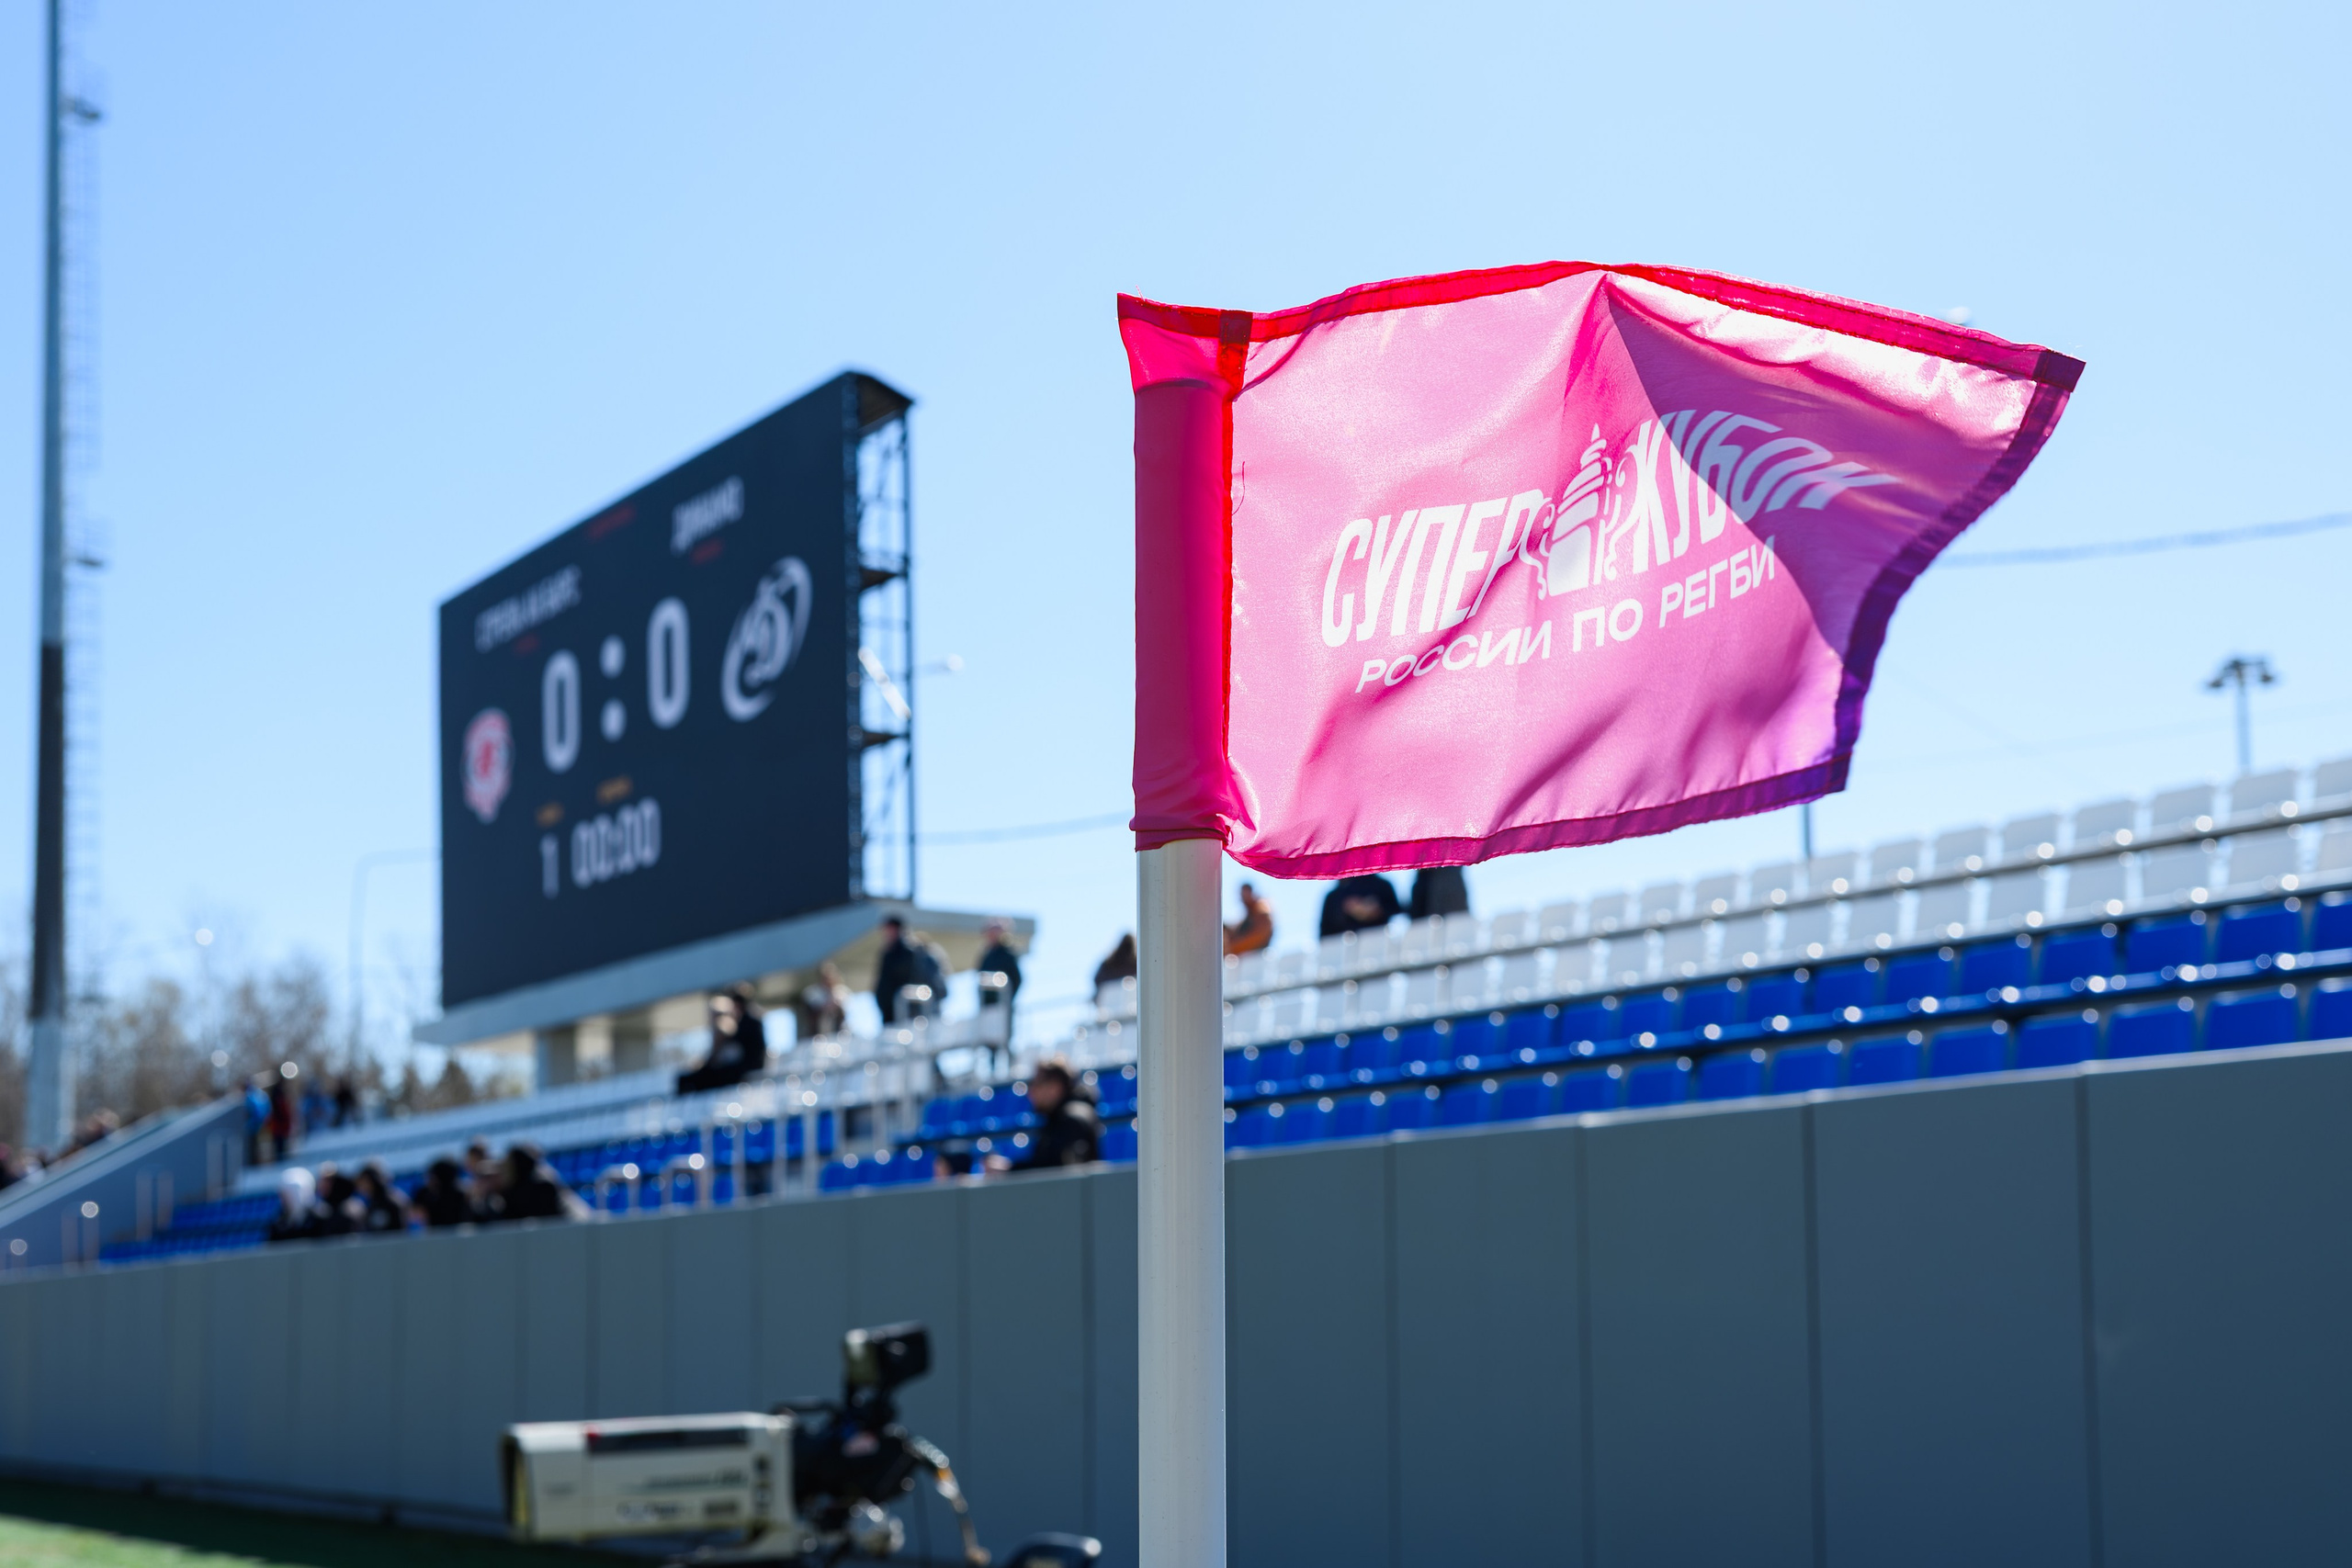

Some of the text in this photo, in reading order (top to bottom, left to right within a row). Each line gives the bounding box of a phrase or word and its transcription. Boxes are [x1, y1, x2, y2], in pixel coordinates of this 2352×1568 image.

[1354, 535, 1775, 694] РОССИИ ПО РЕГБИ
[571, 797, 662, 888] 00:00
